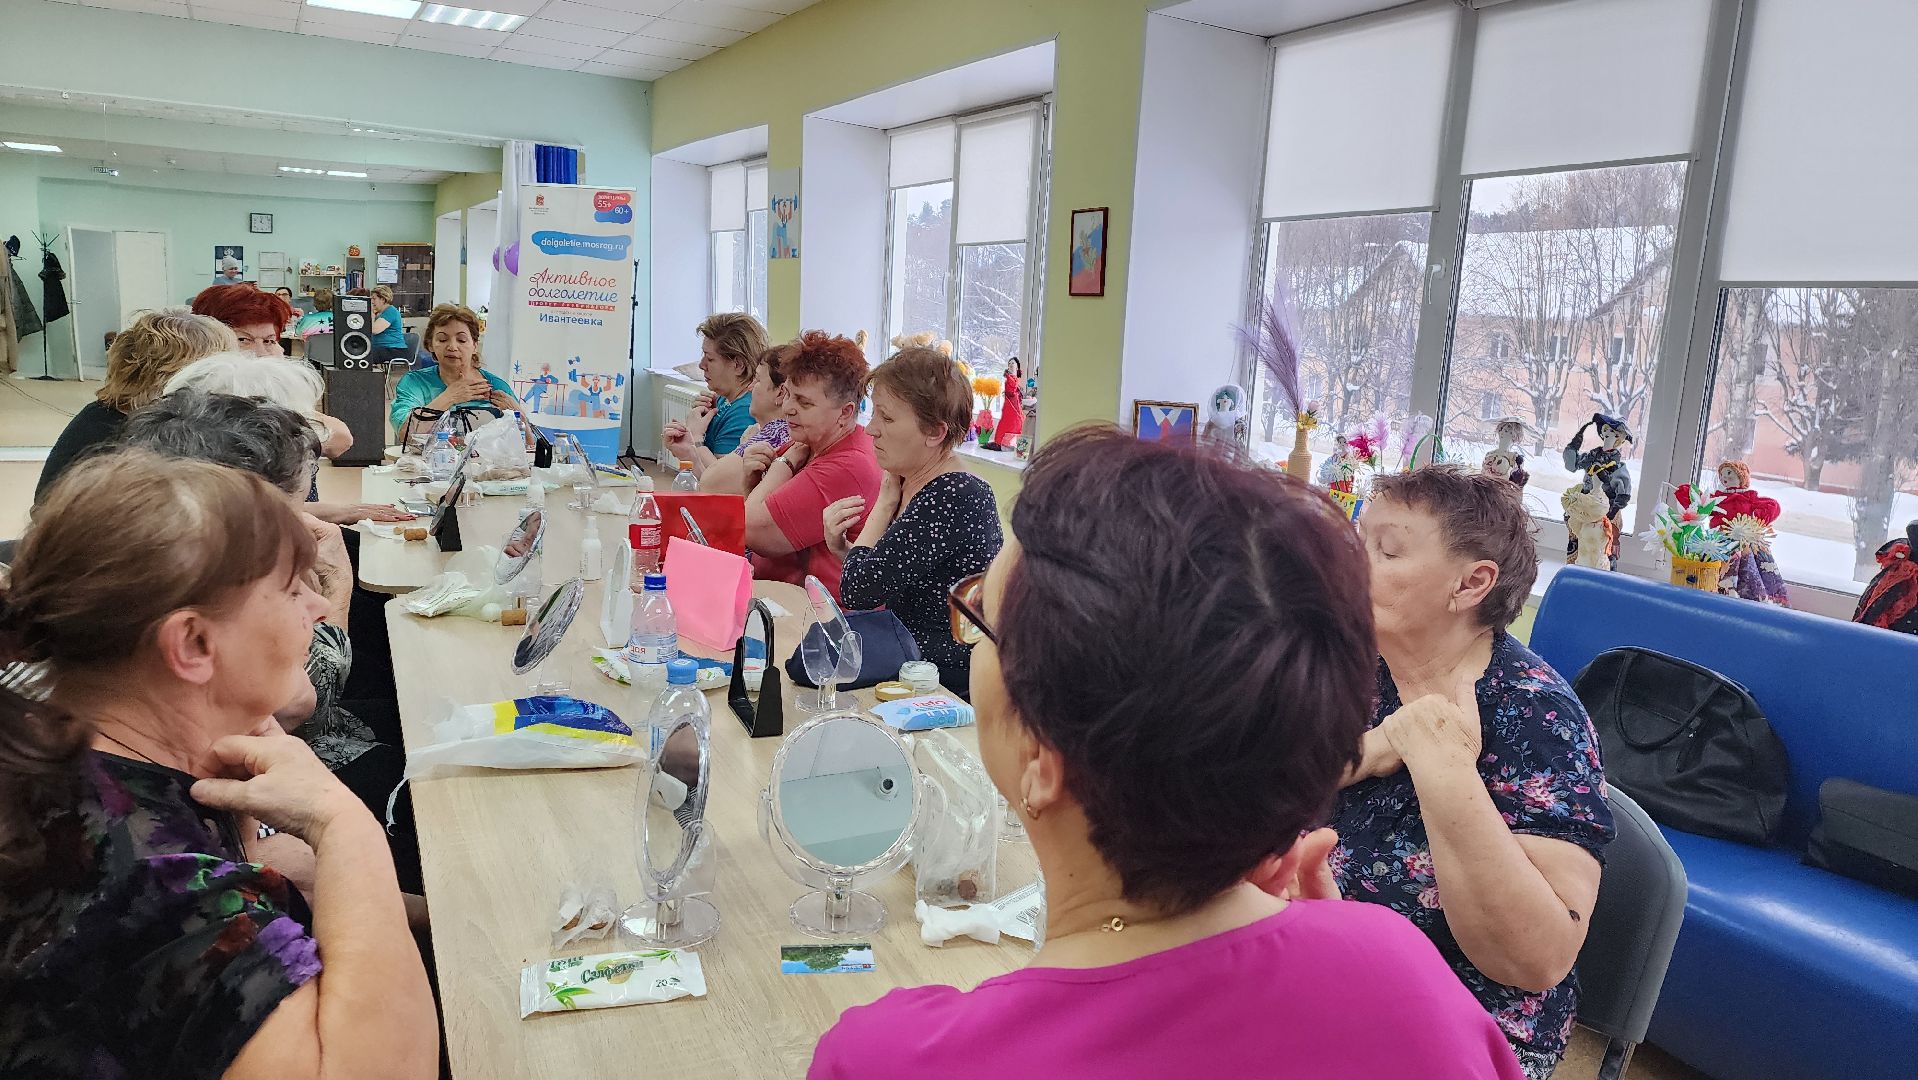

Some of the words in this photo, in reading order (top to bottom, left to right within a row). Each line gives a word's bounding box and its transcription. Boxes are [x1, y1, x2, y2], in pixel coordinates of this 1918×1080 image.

[597, 200, 612, 208] 55+
[614, 206, 629, 214] 60+
[541, 237, 624, 251] dolgoletie.mosreg.ru
[529, 267, 617, 288] Активное
[528, 287, 618, 302] долголетие
[539, 313, 603, 326] Ивантеевка
[581, 960, 644, 985] Салфетки
[655, 979, 668, 988] 20
